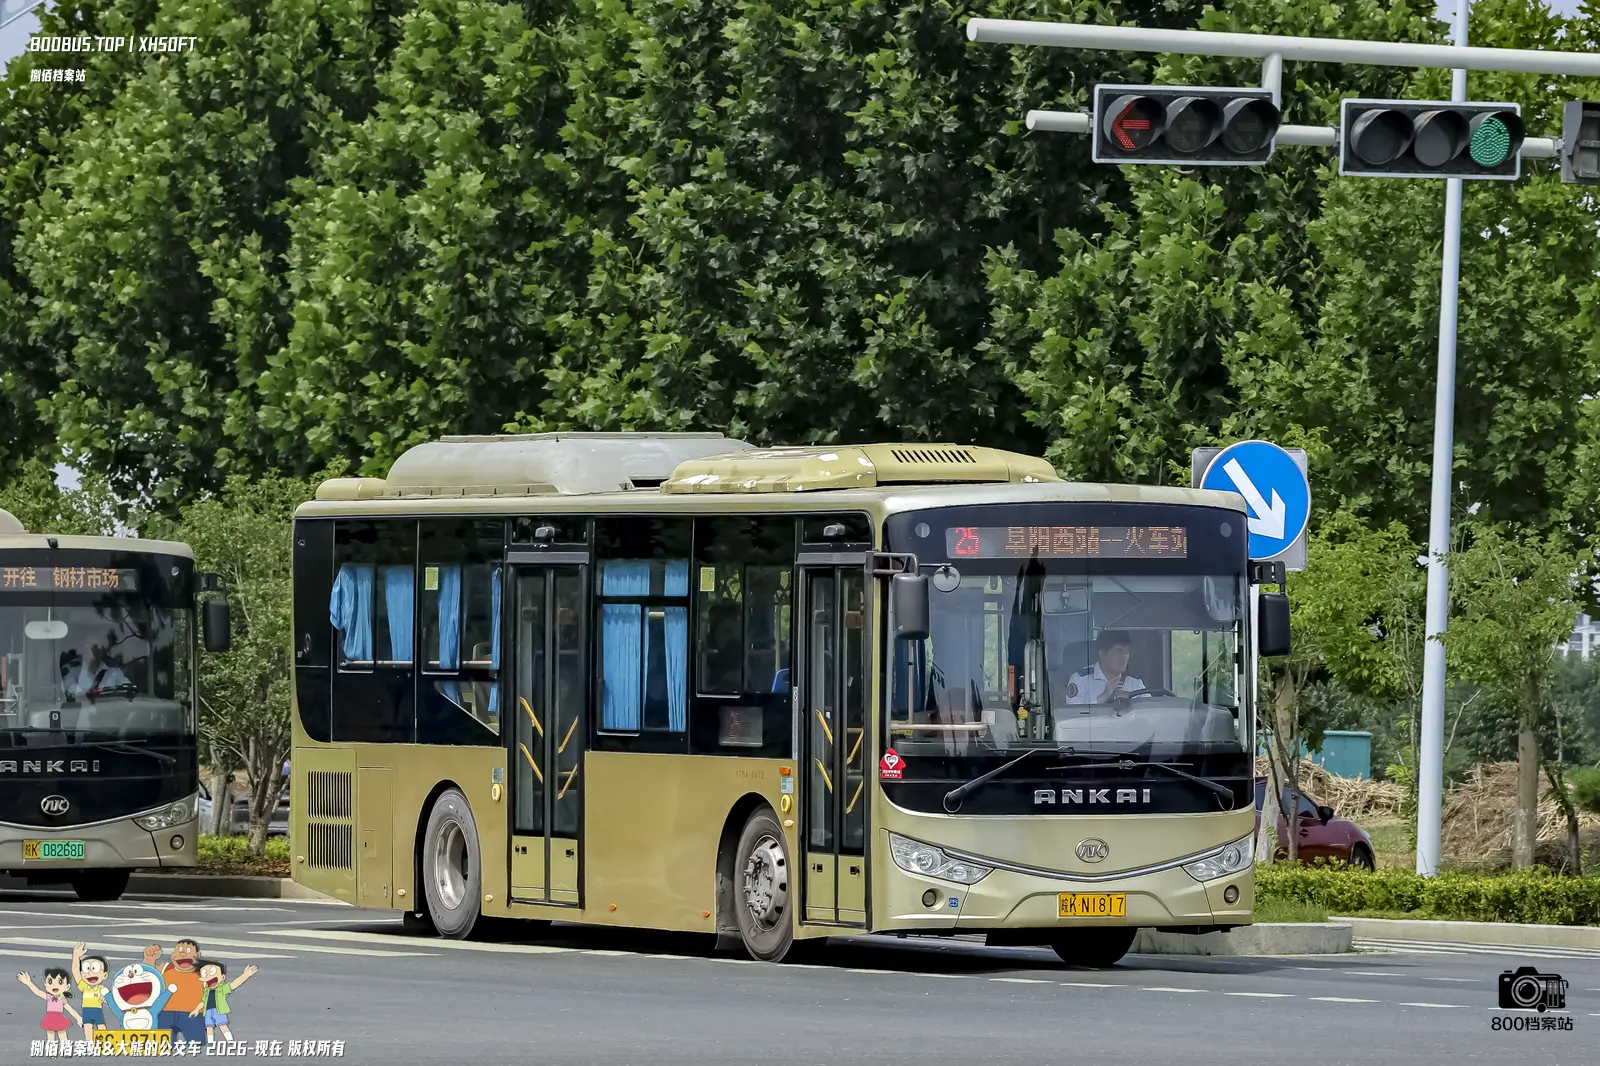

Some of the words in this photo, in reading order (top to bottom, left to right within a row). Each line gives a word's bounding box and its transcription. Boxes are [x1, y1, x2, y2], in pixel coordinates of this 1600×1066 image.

[955, 527, 980, 555] 25
[3, 567, 37, 588] 开往
[53, 567, 119, 588] 钢材市场
[0, 760, 100, 773] ANKAI
[1034, 788, 1151, 805] ANKAI
